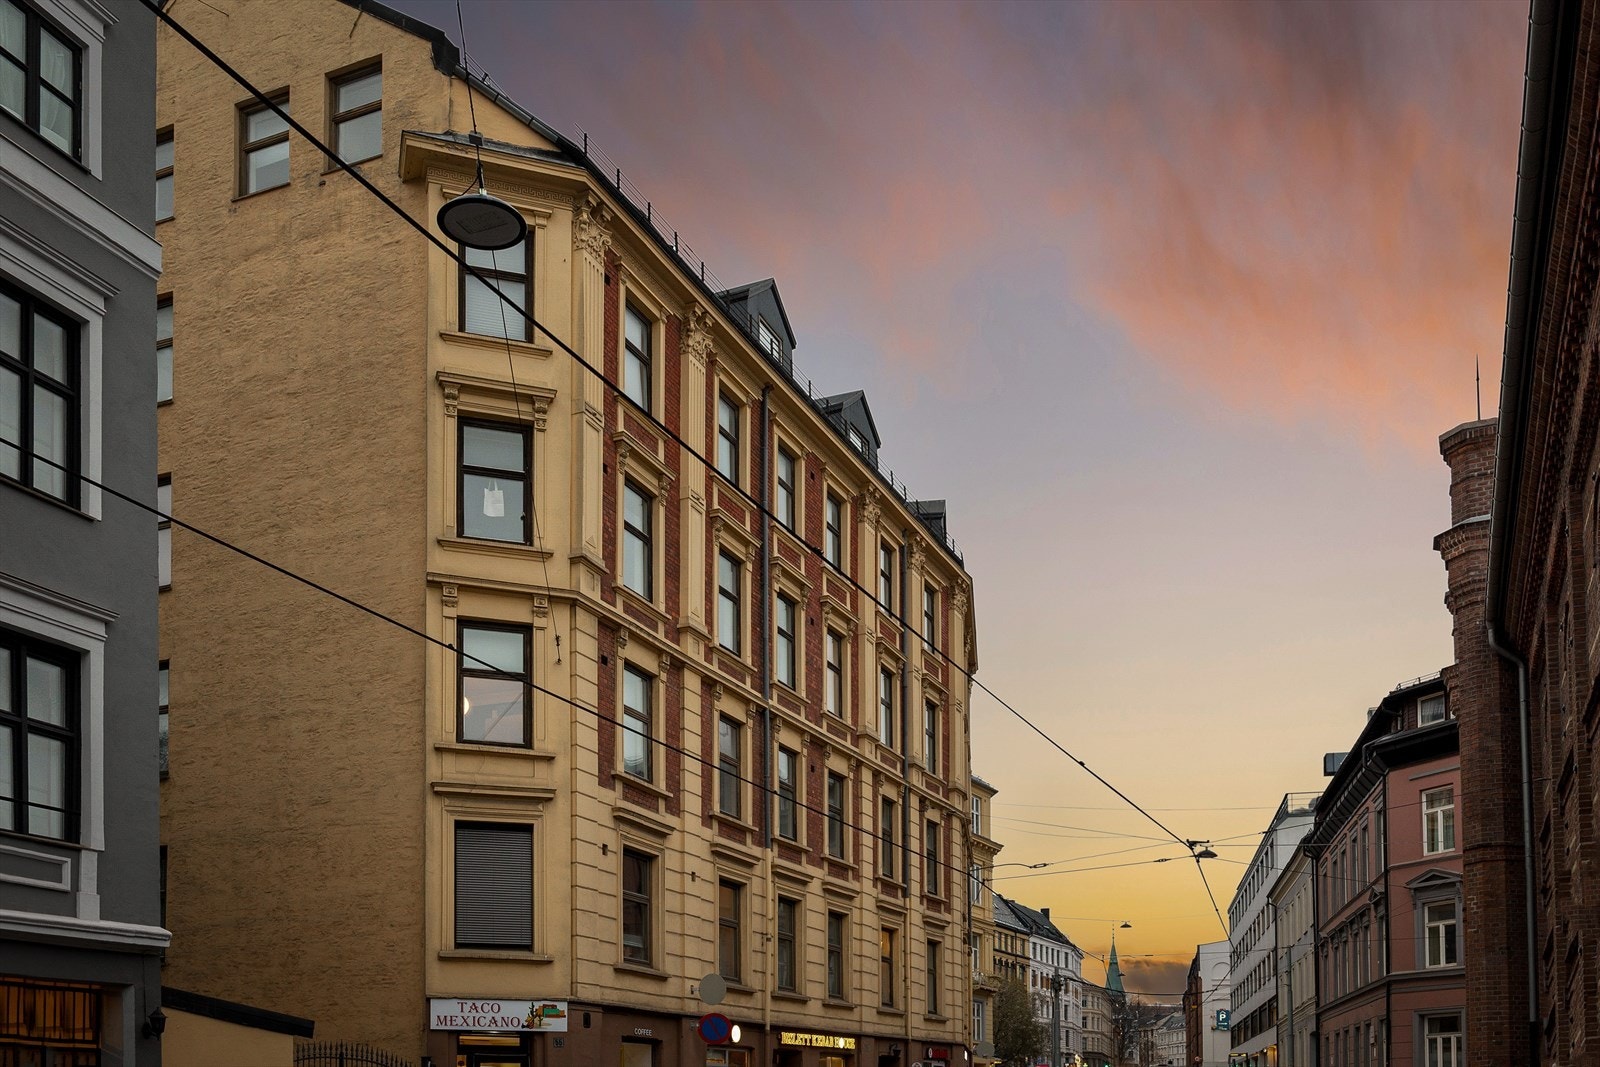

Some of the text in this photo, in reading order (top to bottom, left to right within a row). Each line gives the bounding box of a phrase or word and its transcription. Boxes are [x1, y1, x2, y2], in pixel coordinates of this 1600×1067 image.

[457, 1002, 501, 1014] TACO
[436, 1015, 520, 1028] MEXICANO
[634, 1027, 652, 1036] COFFEE
[834, 1037, 855, 1049] HUSE
